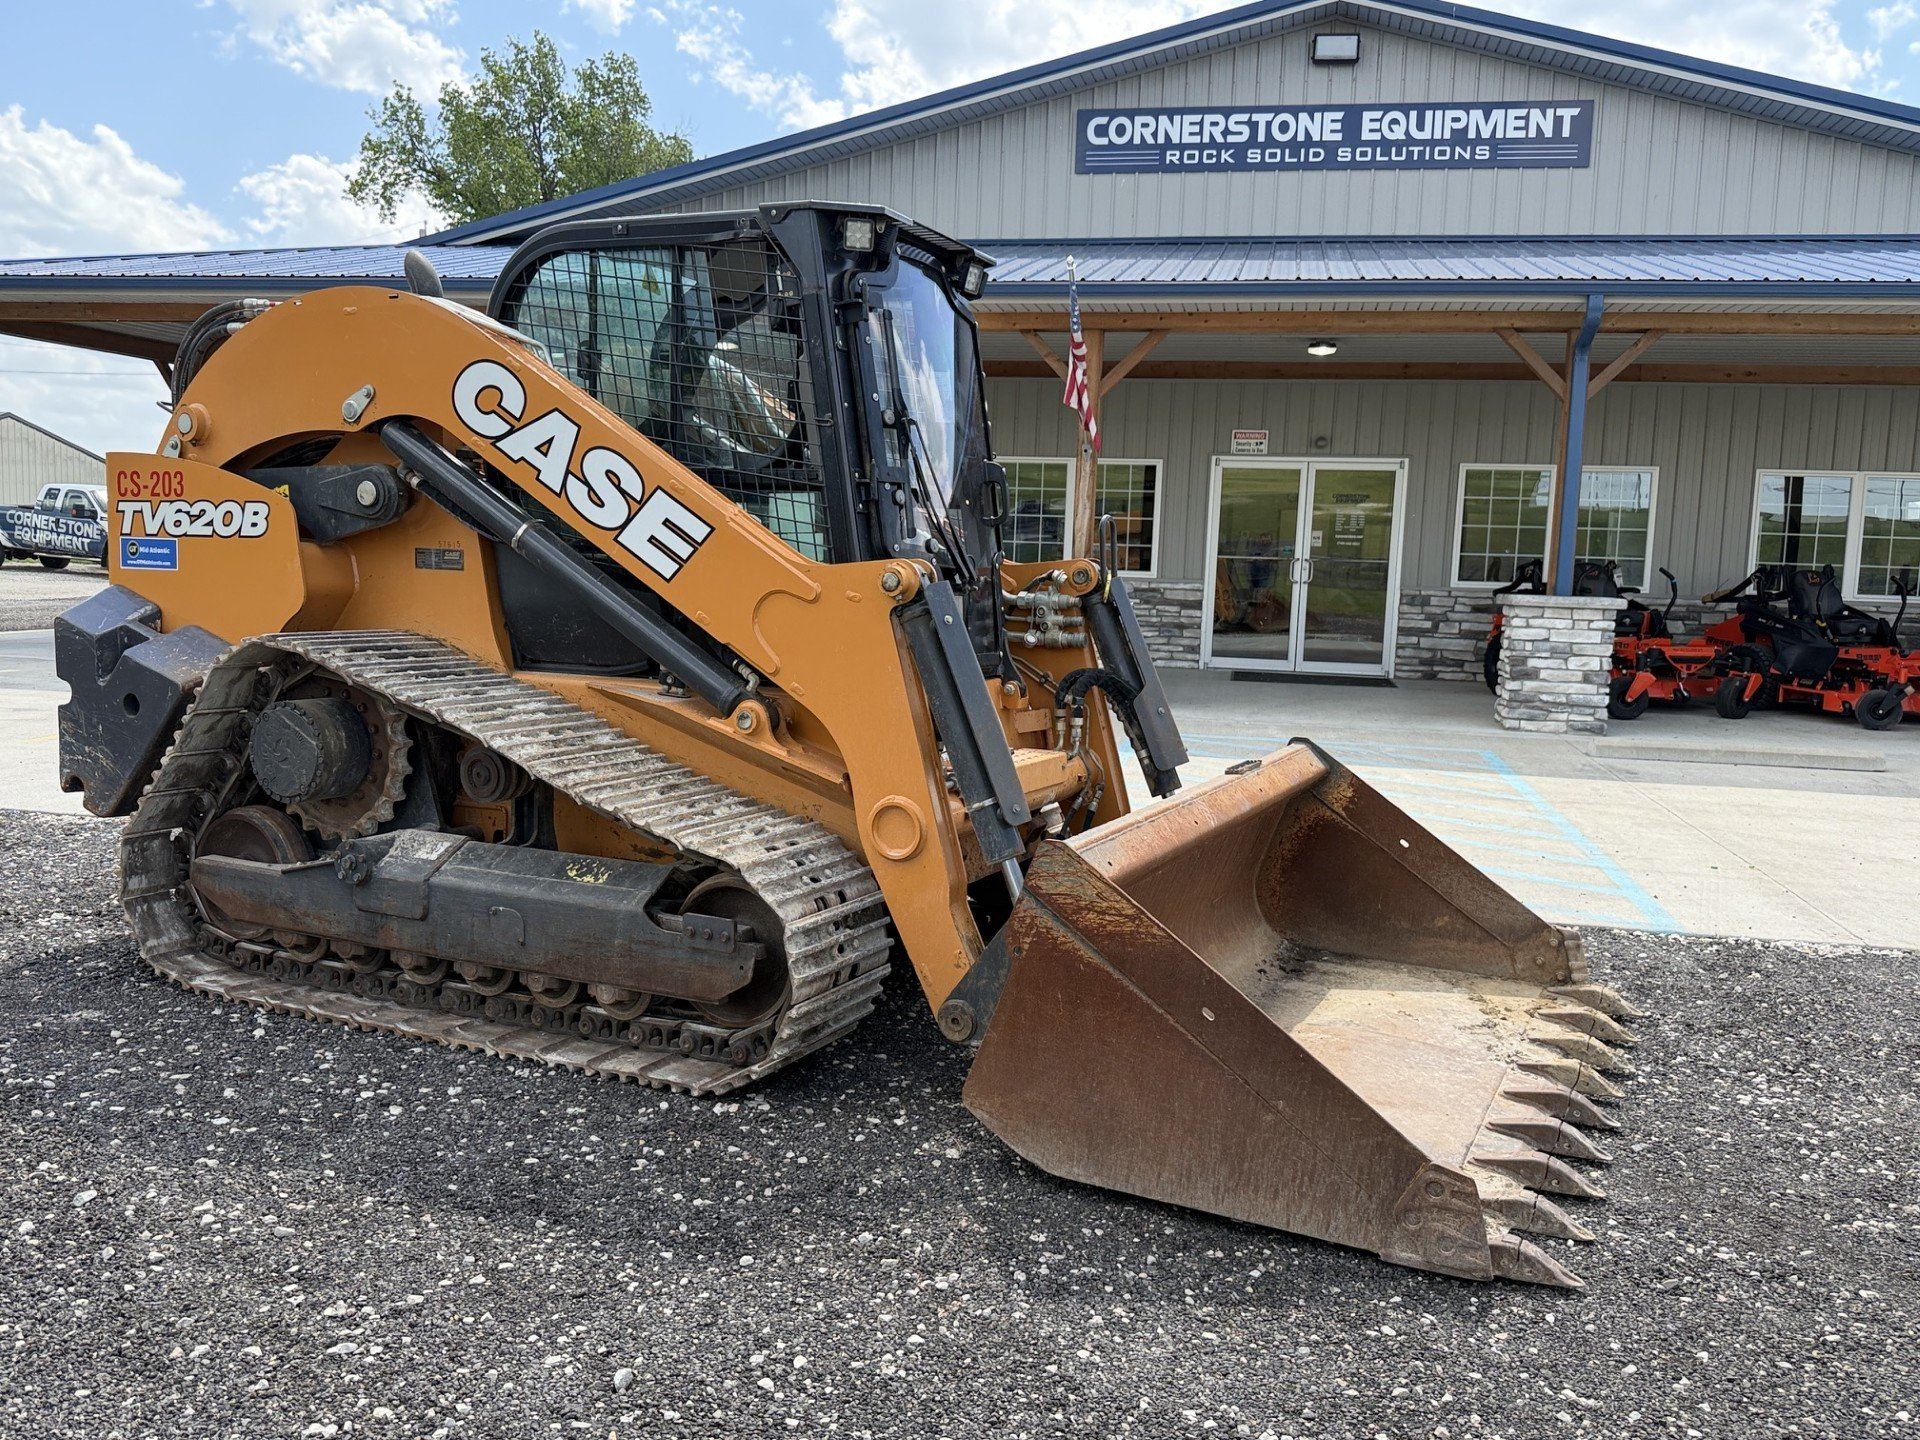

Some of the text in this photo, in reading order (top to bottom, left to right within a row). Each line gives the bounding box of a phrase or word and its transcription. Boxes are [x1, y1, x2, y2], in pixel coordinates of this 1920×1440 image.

[1086, 107, 1581, 145] CORNERSTONE EQUIPMENT
[1165, 145, 1490, 164] ROCK SOLID SOLUTIONS
[1235, 432, 1266, 440] WARNING
[116, 470, 184, 498] CS-203
[452, 359, 716, 584] CASE
[5, 509, 102, 540] CORNERSTONE
[116, 500, 270, 538] TV620B
[13, 525, 92, 552] EQUIPMENT
